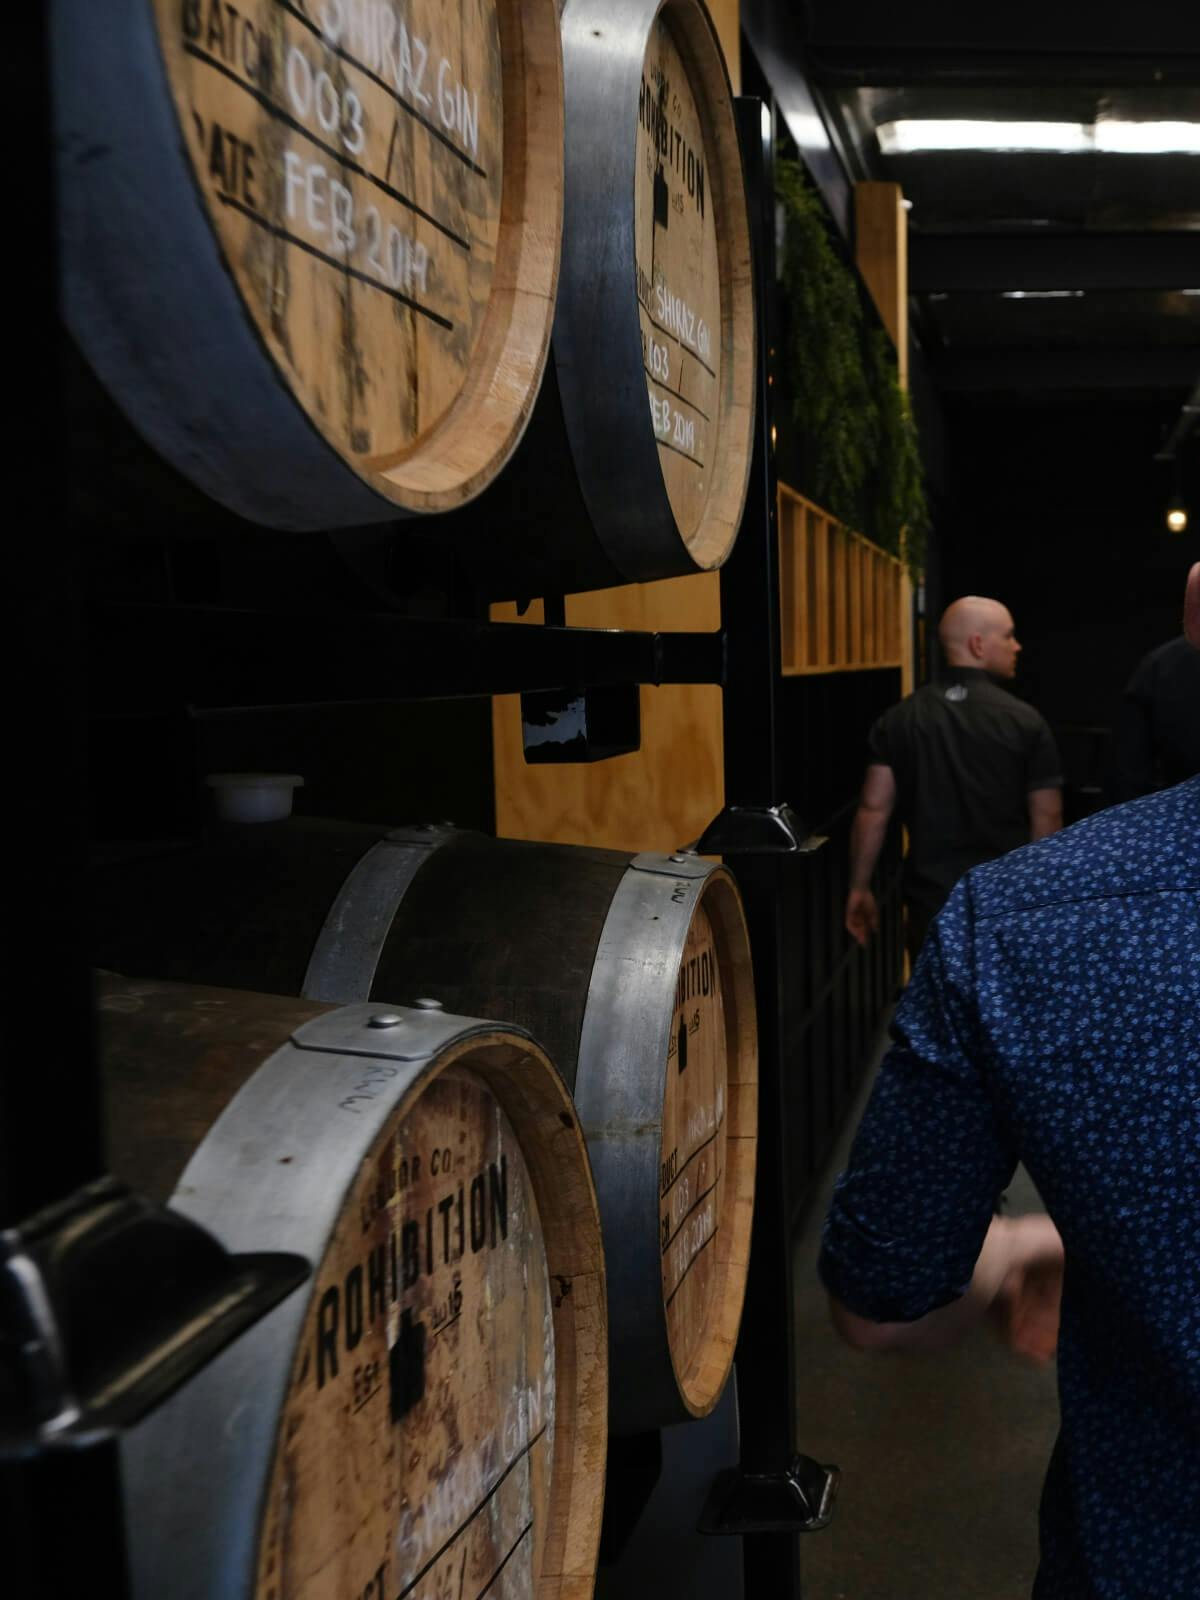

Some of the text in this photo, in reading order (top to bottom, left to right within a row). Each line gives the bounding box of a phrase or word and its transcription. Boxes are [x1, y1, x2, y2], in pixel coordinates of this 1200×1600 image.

[286, 46, 365, 157] 003
[437, 57, 478, 157] GIN
[193, 104, 256, 208] ATE
[283, 149, 357, 253] FEB
[656, 284, 697, 347] SHIRAZ
